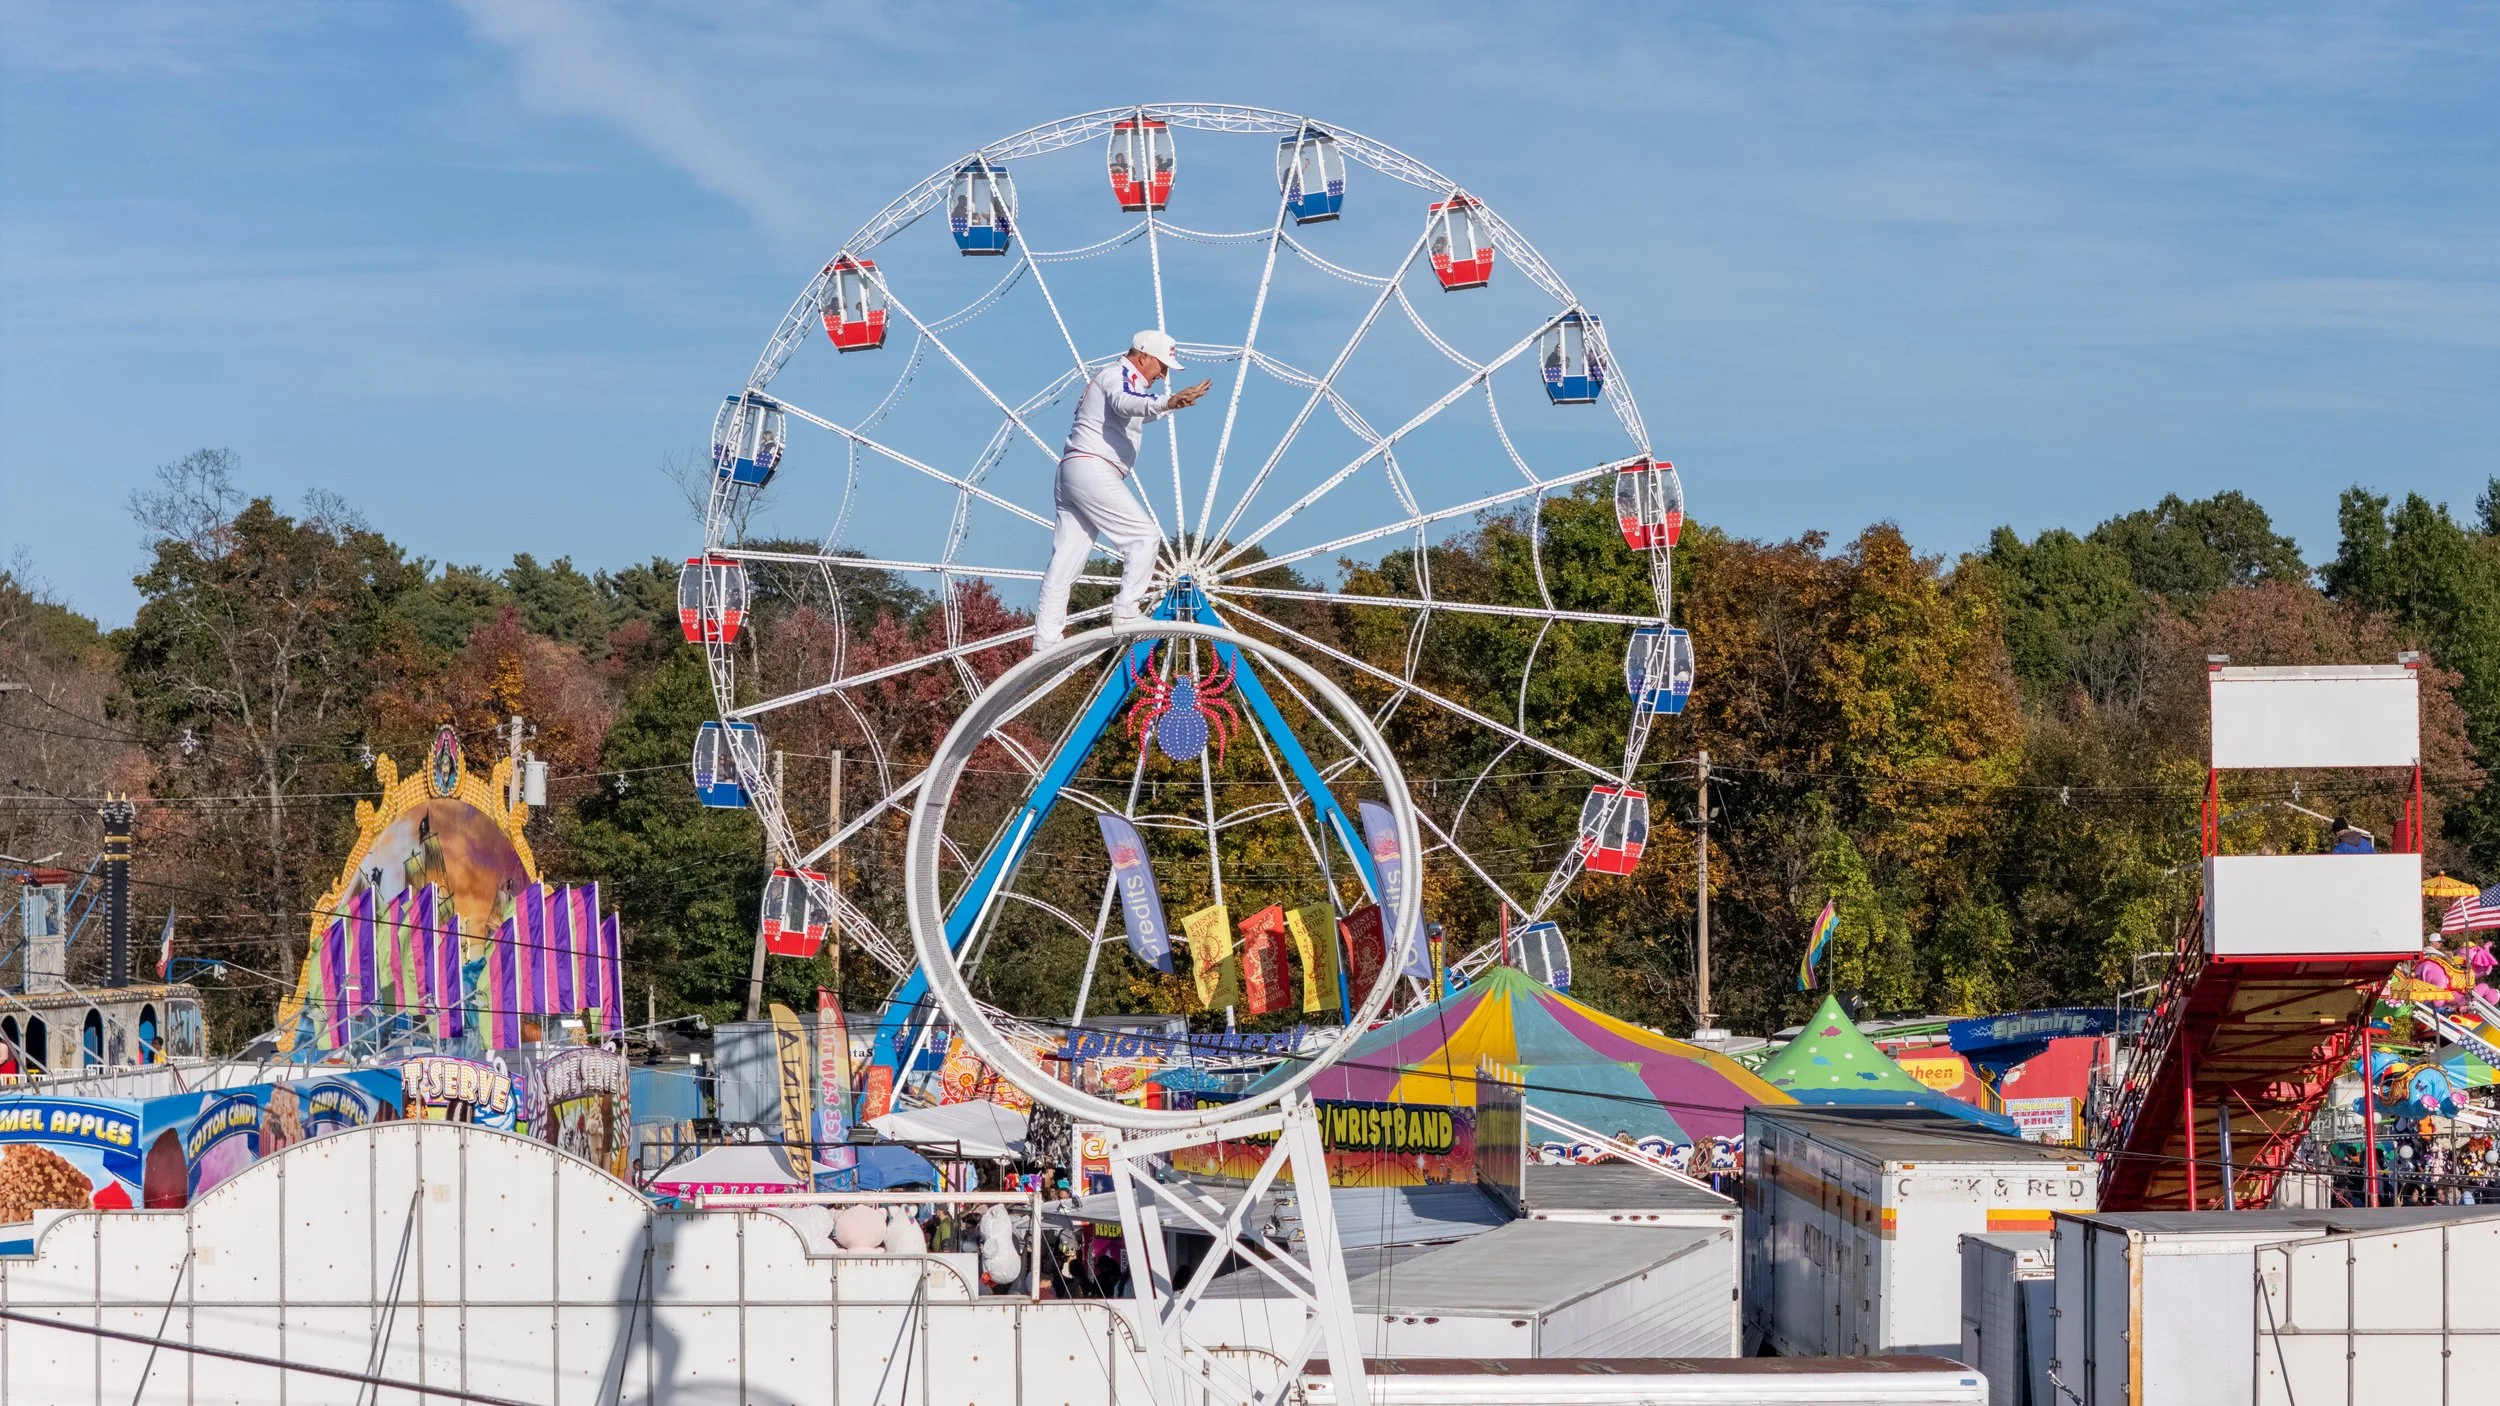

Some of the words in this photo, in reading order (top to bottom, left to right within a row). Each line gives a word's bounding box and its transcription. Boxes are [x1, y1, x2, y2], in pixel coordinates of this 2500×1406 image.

[1126, 874, 1161, 964] Credits
[1191, 918, 1220, 939] SHOWS
[1294, 907, 1326, 928] FIESTA
[1296, 917, 1326, 937] SHOWS
[427, 1059, 512, 1114] SERVE
[309, 1091, 340, 1115] CANDY
[338, 1092, 369, 1126] APPLES
[50, 1110, 134, 1147] APPLES
[188, 1109, 227, 1159] COTTON
[227, 1101, 257, 1127] CANDY
[1993, 1178, 2009, 1197] &
